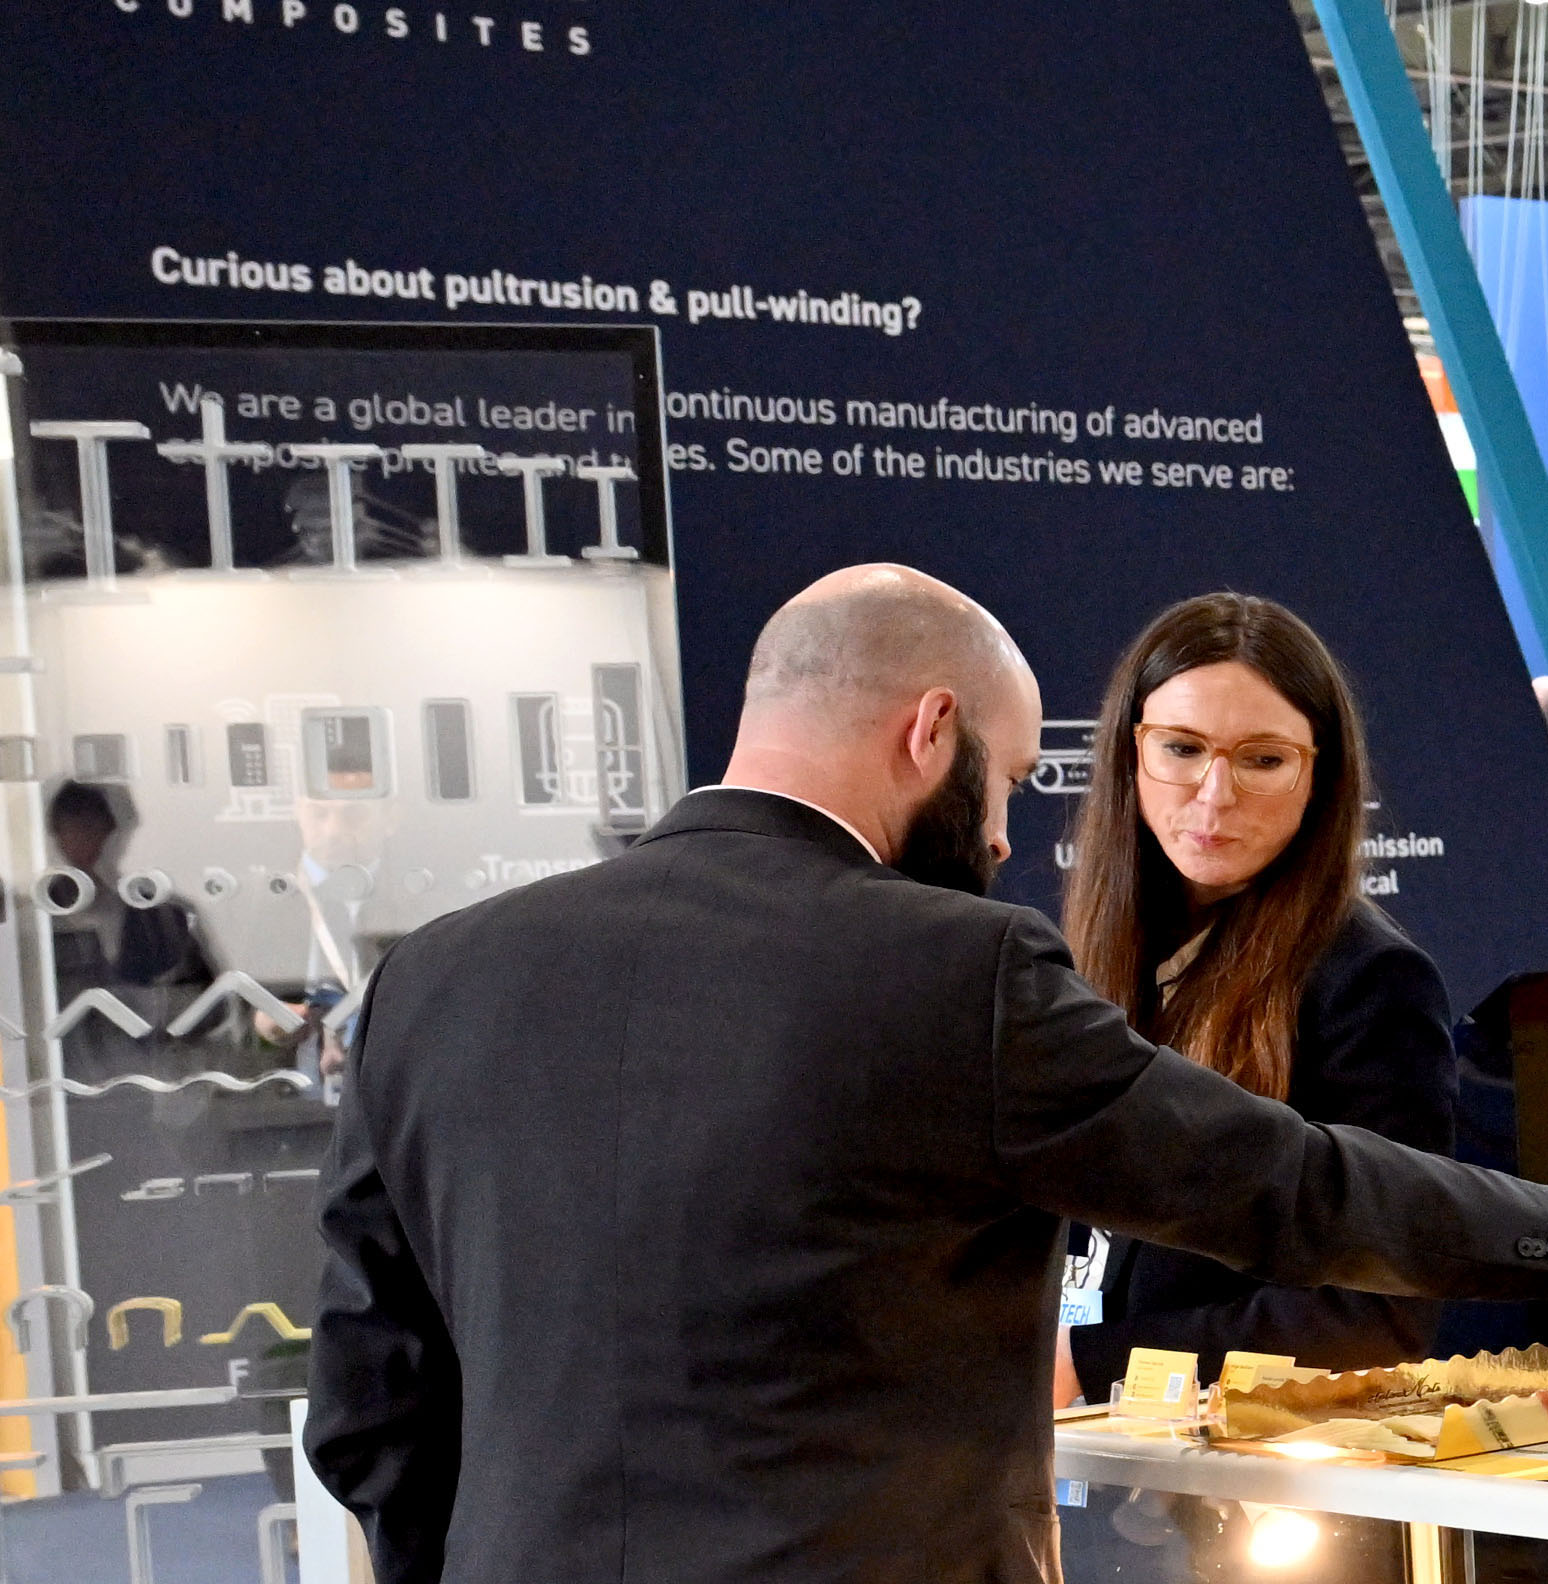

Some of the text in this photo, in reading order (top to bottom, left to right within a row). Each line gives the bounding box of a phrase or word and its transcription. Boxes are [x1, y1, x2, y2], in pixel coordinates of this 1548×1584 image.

[152, 247, 921, 336] Curious about pultrusion & pull-winding?
[237, 392, 596, 432] are a global leader
[846, 397, 1264, 444] manufacturing of advanced
[726, 437, 1295, 492] Some of the industries we serve are:
